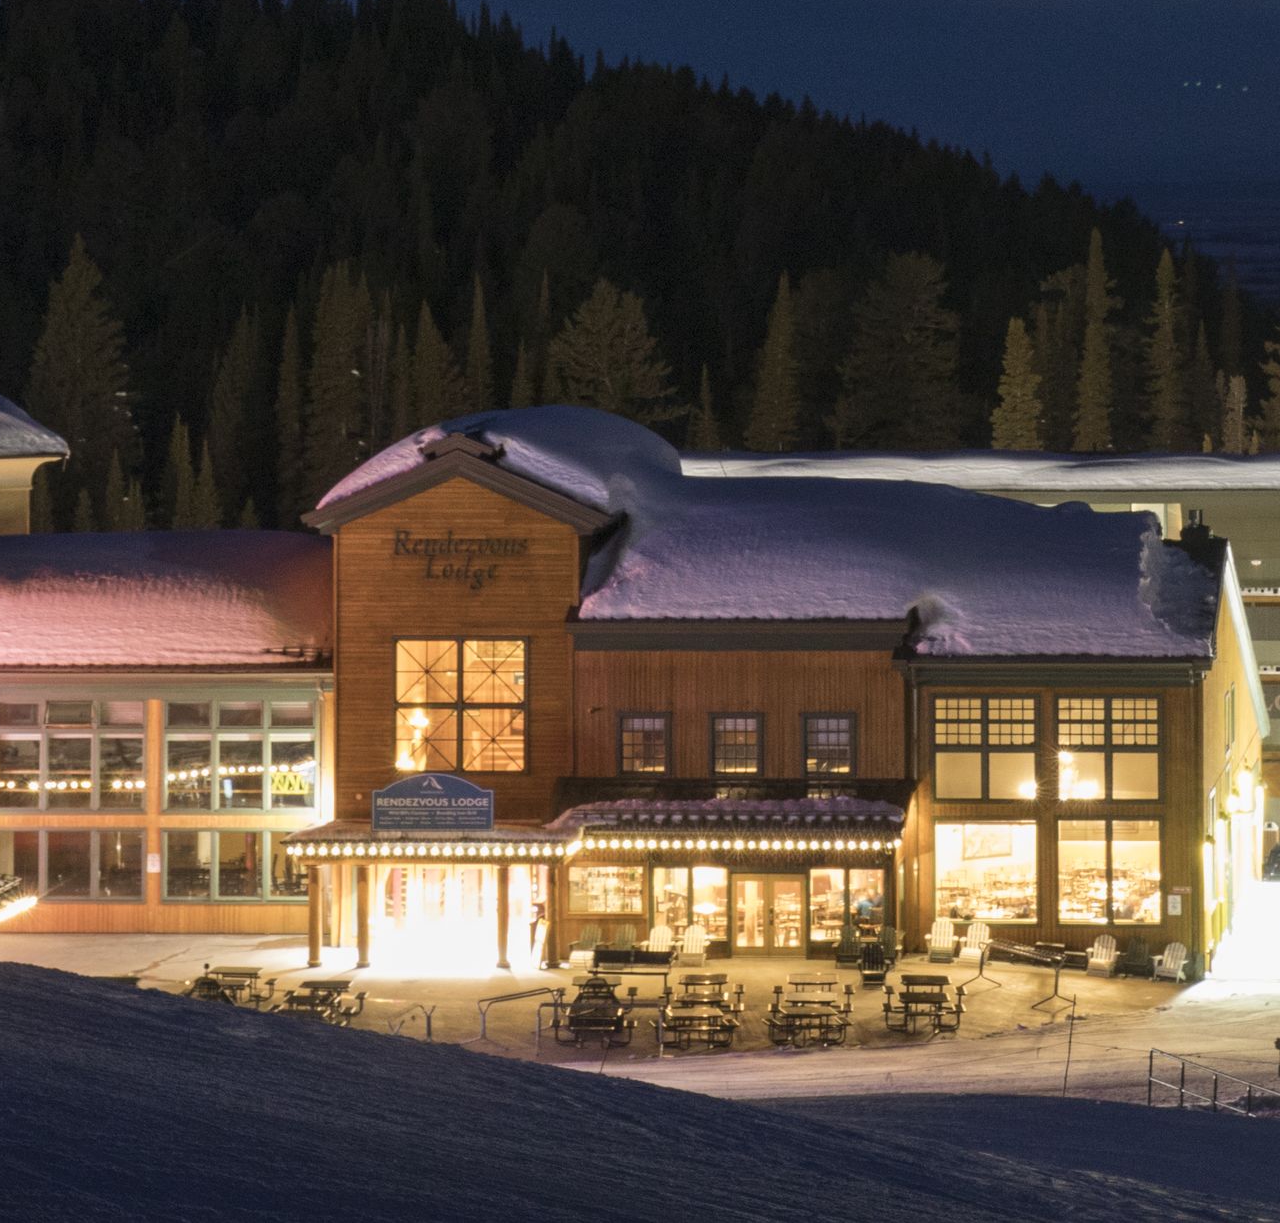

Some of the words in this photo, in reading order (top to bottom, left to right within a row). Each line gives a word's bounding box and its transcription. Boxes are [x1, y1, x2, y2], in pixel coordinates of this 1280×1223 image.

[394, 530, 529, 556] Rendezvous
[424, 554, 498, 590] Lodge
[376, 798, 448, 807] RENDEZVOUS
[451, 798, 489, 807] LODGE
